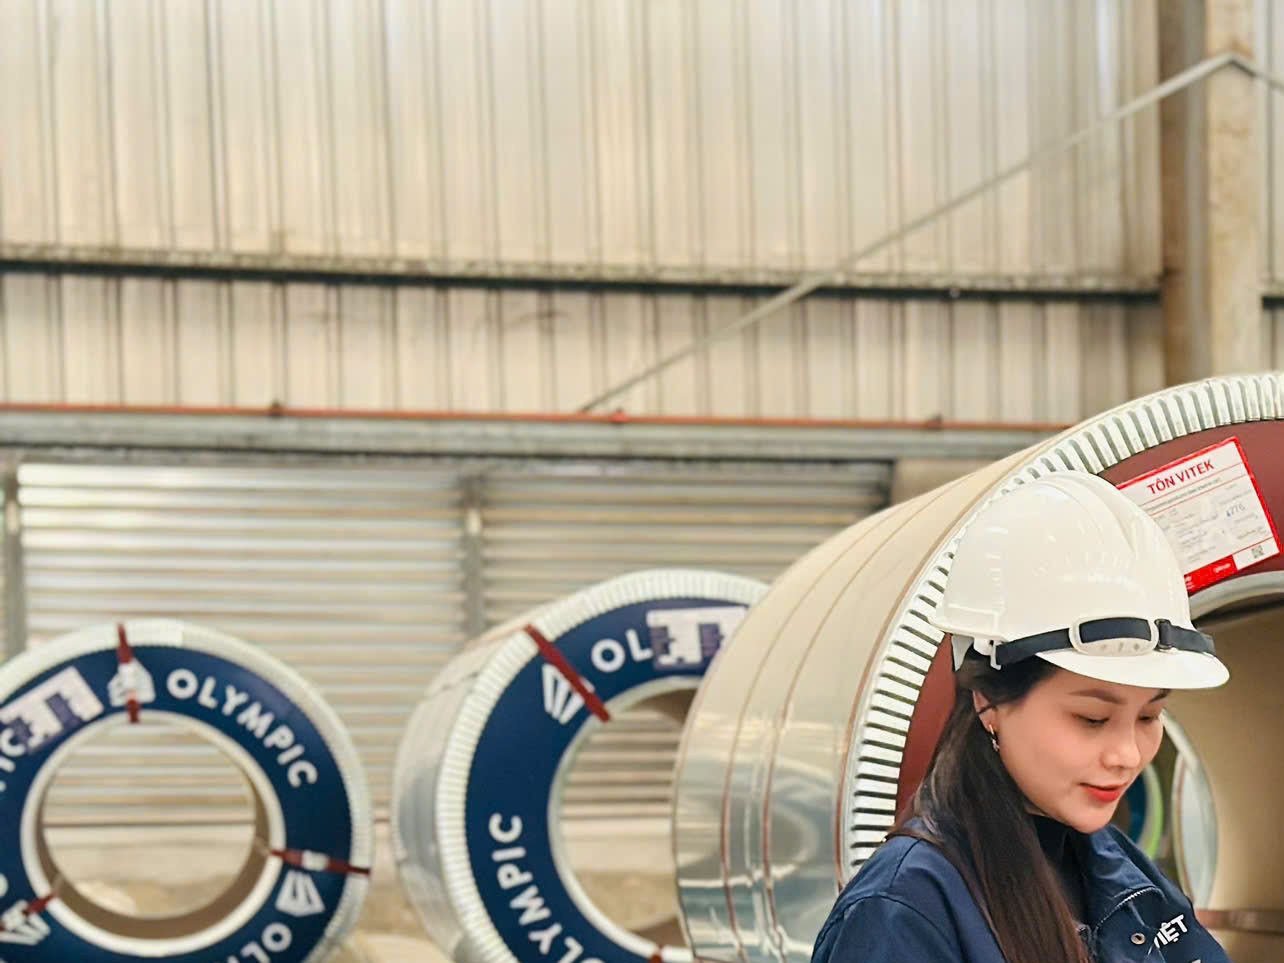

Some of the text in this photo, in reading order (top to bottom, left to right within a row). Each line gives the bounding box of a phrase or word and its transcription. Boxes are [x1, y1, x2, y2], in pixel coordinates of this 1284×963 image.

[1147, 474, 1176, 495] TÔN
[1175, 459, 1215, 484] VITEK
[591, 628, 653, 673] OL
[167, 669, 317, 788] OLYMPIC
